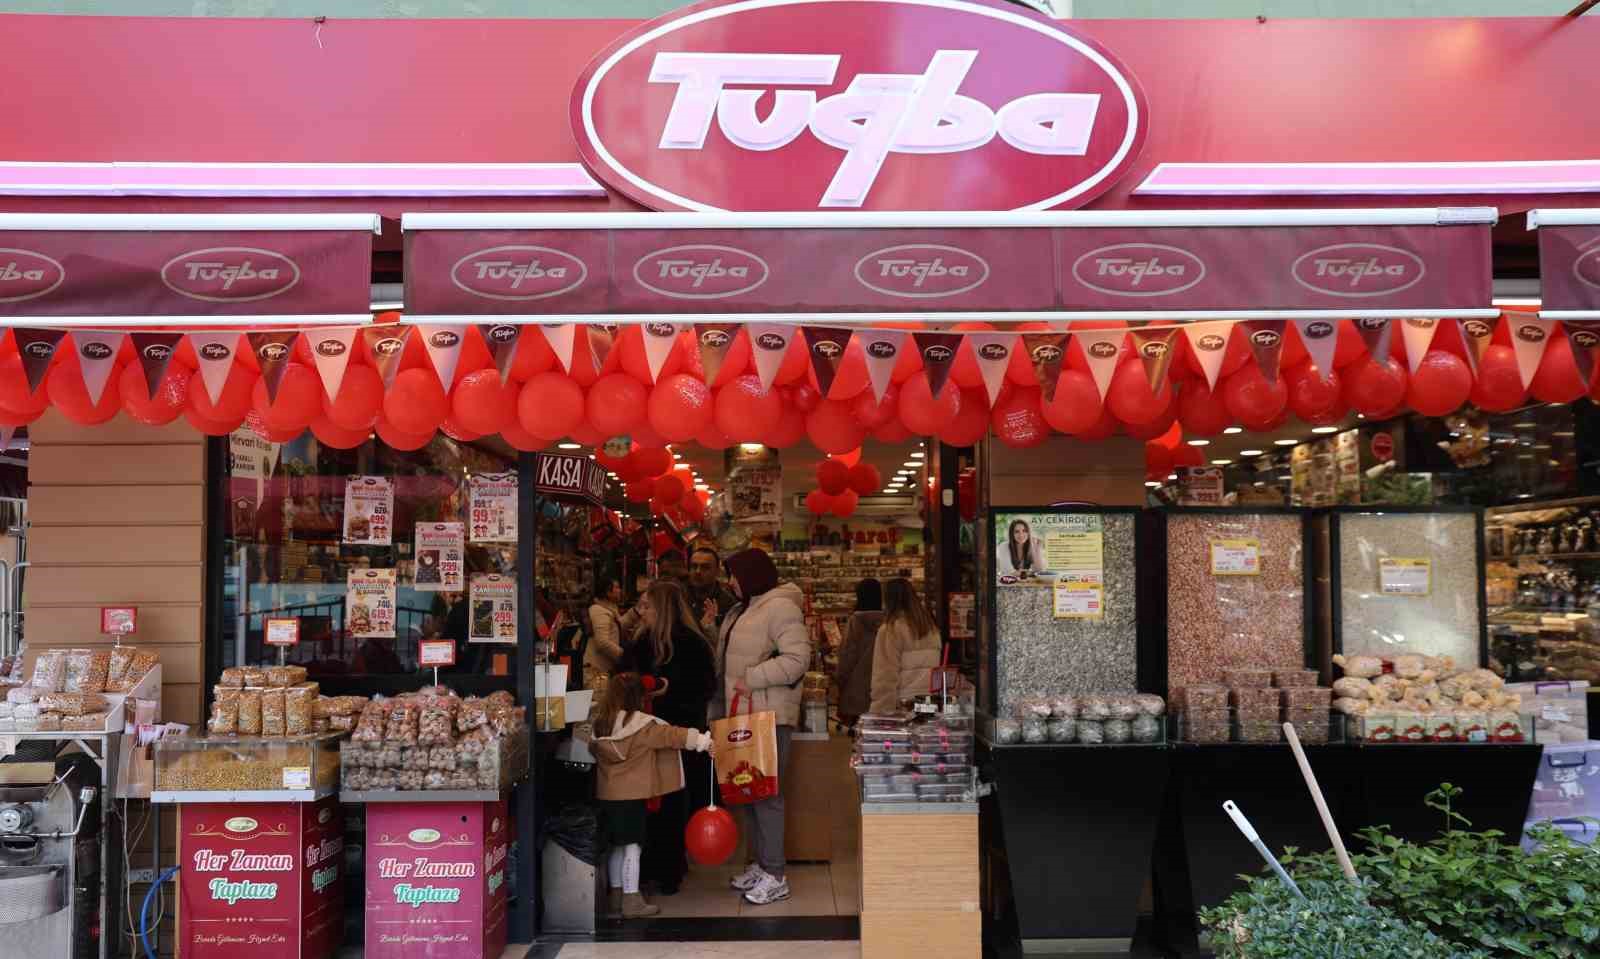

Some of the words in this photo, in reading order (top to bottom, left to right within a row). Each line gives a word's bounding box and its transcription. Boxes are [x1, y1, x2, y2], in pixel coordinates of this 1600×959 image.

[540, 456, 581, 488] KASA
[194, 849, 229, 871] Her
[229, 849, 293, 871] Zaman
[379, 858, 412, 878] Her
[413, 858, 475, 878] Zaman
[209, 877, 278, 905] Taptaze
[394, 883, 460, 908] Taptaze
